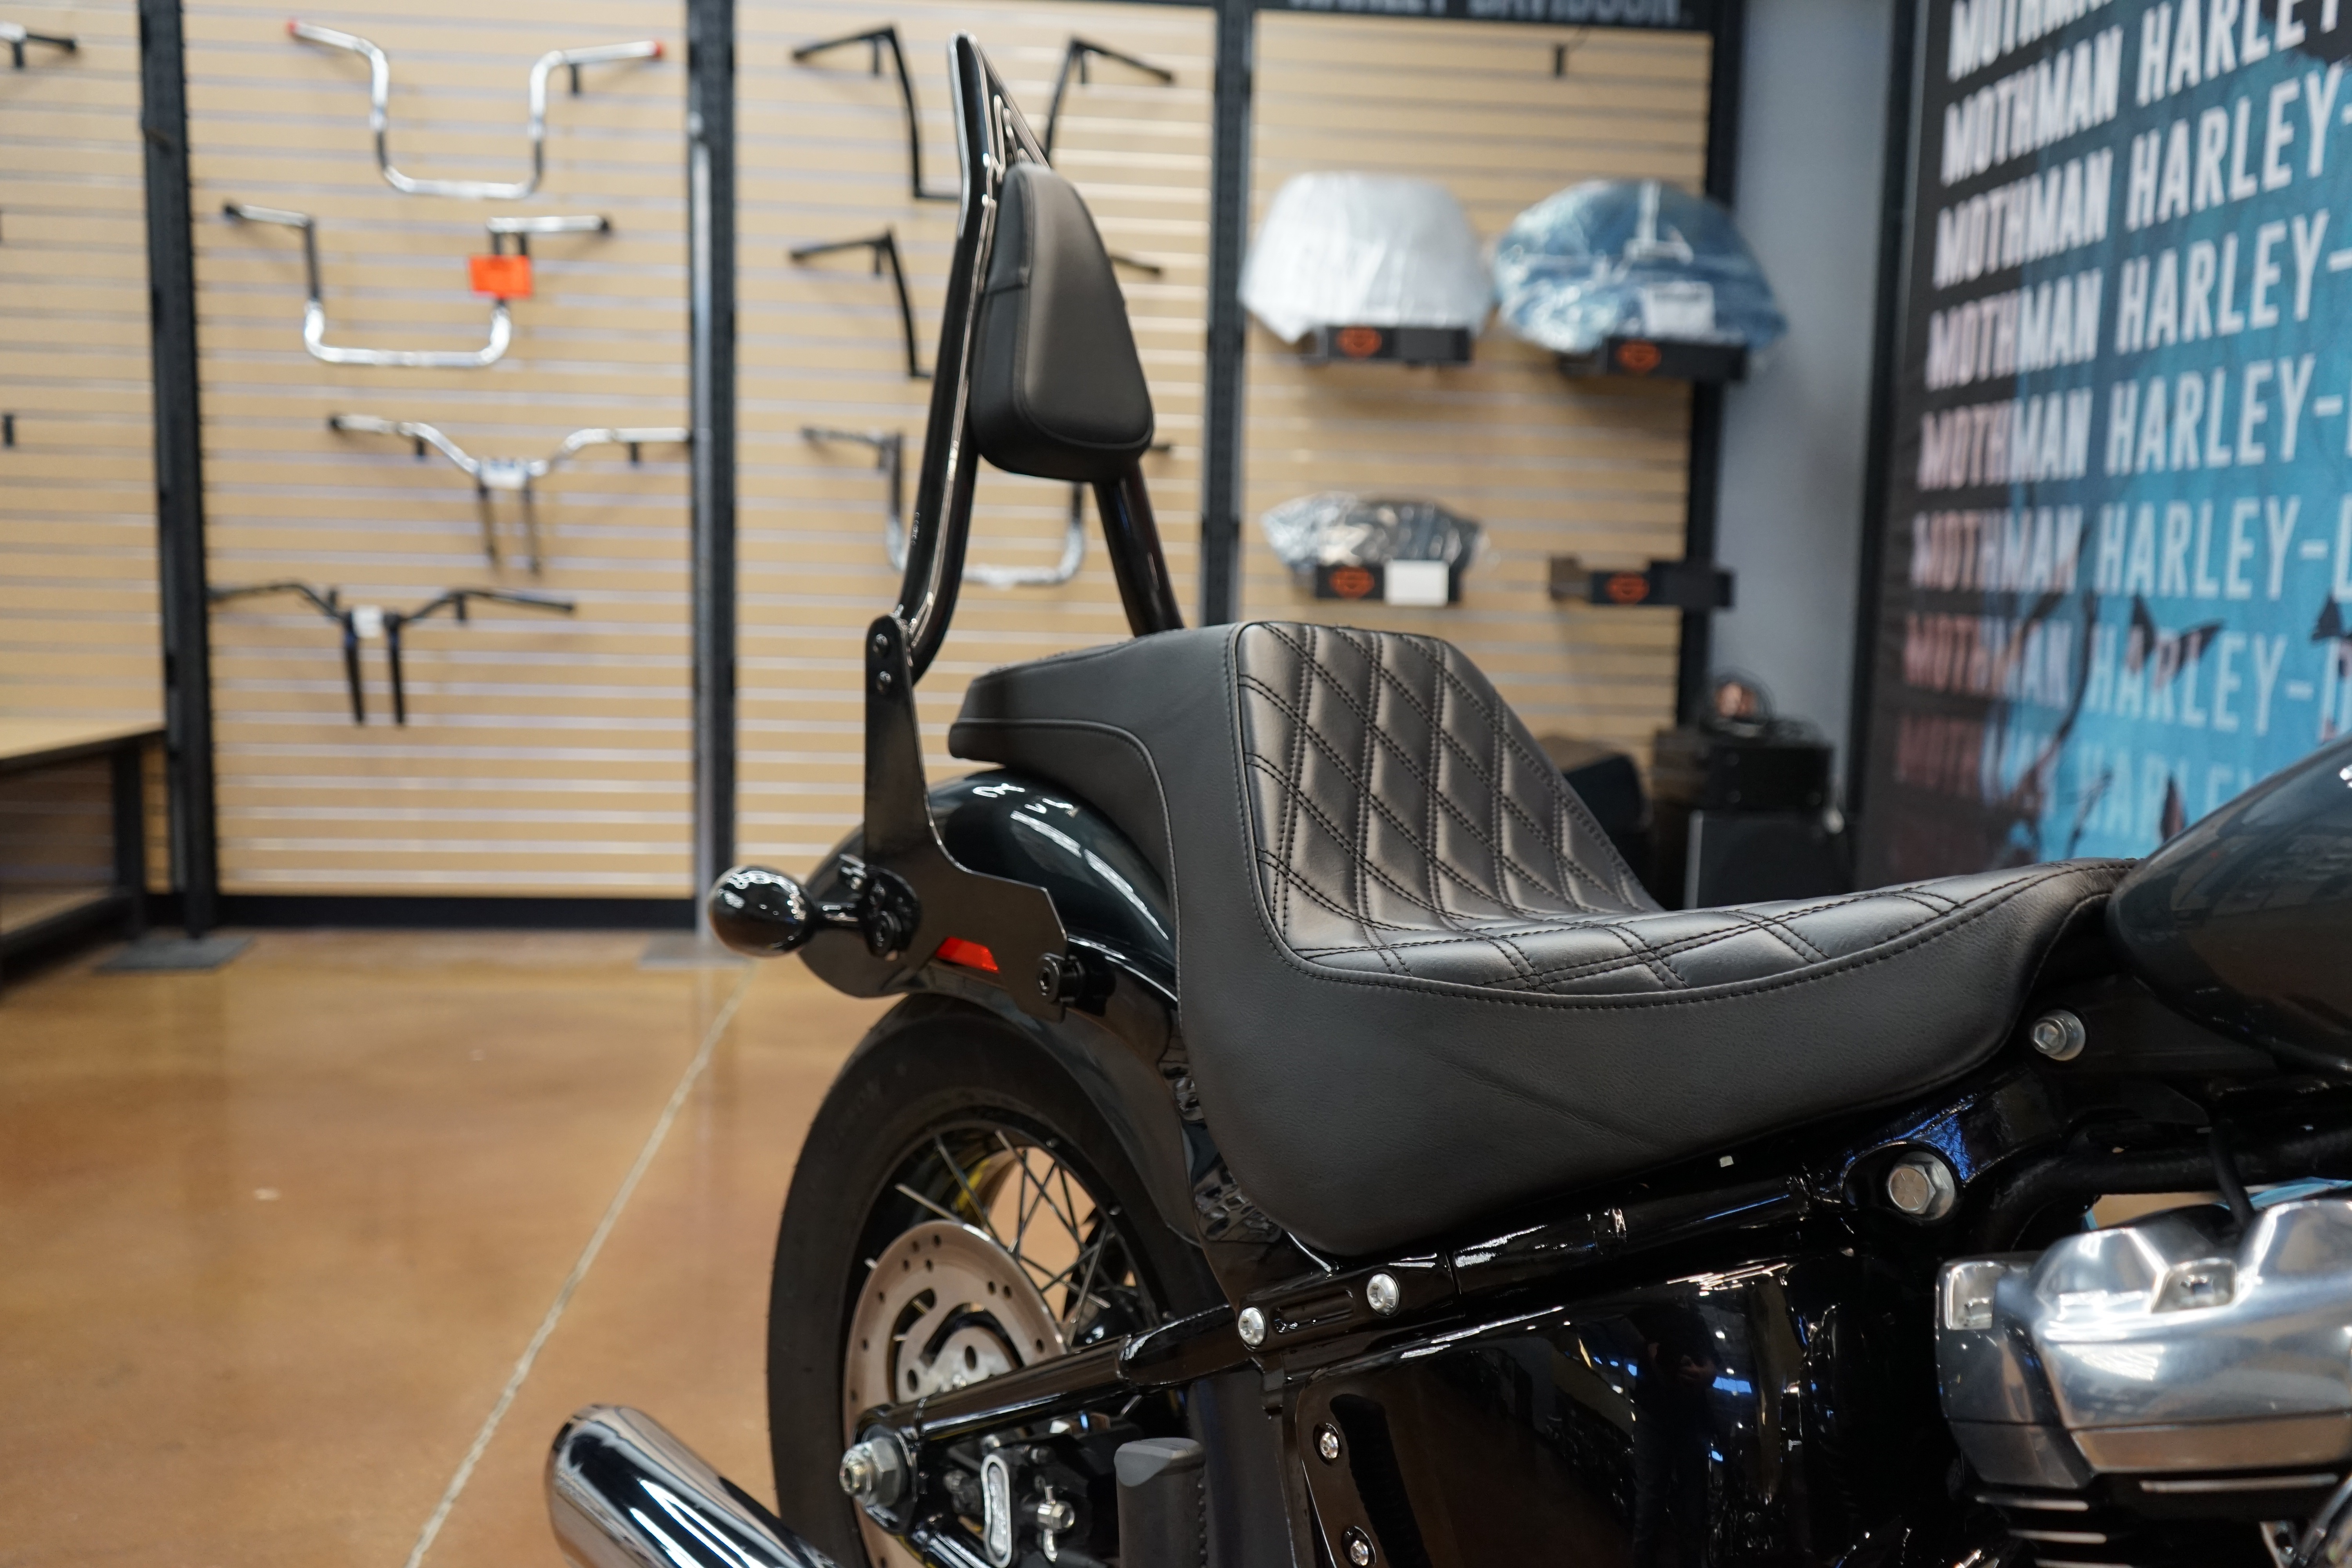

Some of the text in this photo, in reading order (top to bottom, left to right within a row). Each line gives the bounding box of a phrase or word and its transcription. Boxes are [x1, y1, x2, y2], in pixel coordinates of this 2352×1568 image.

[1941, 24, 2124, 187] MOTHMAN
[1933, 146, 2114, 290] MOTHMAN
[1924, 267, 2103, 390] MOTHMAN
[1917, 387, 2093, 492] MOTHMAN
[1909, 504, 2083, 593] MOTHMAN
